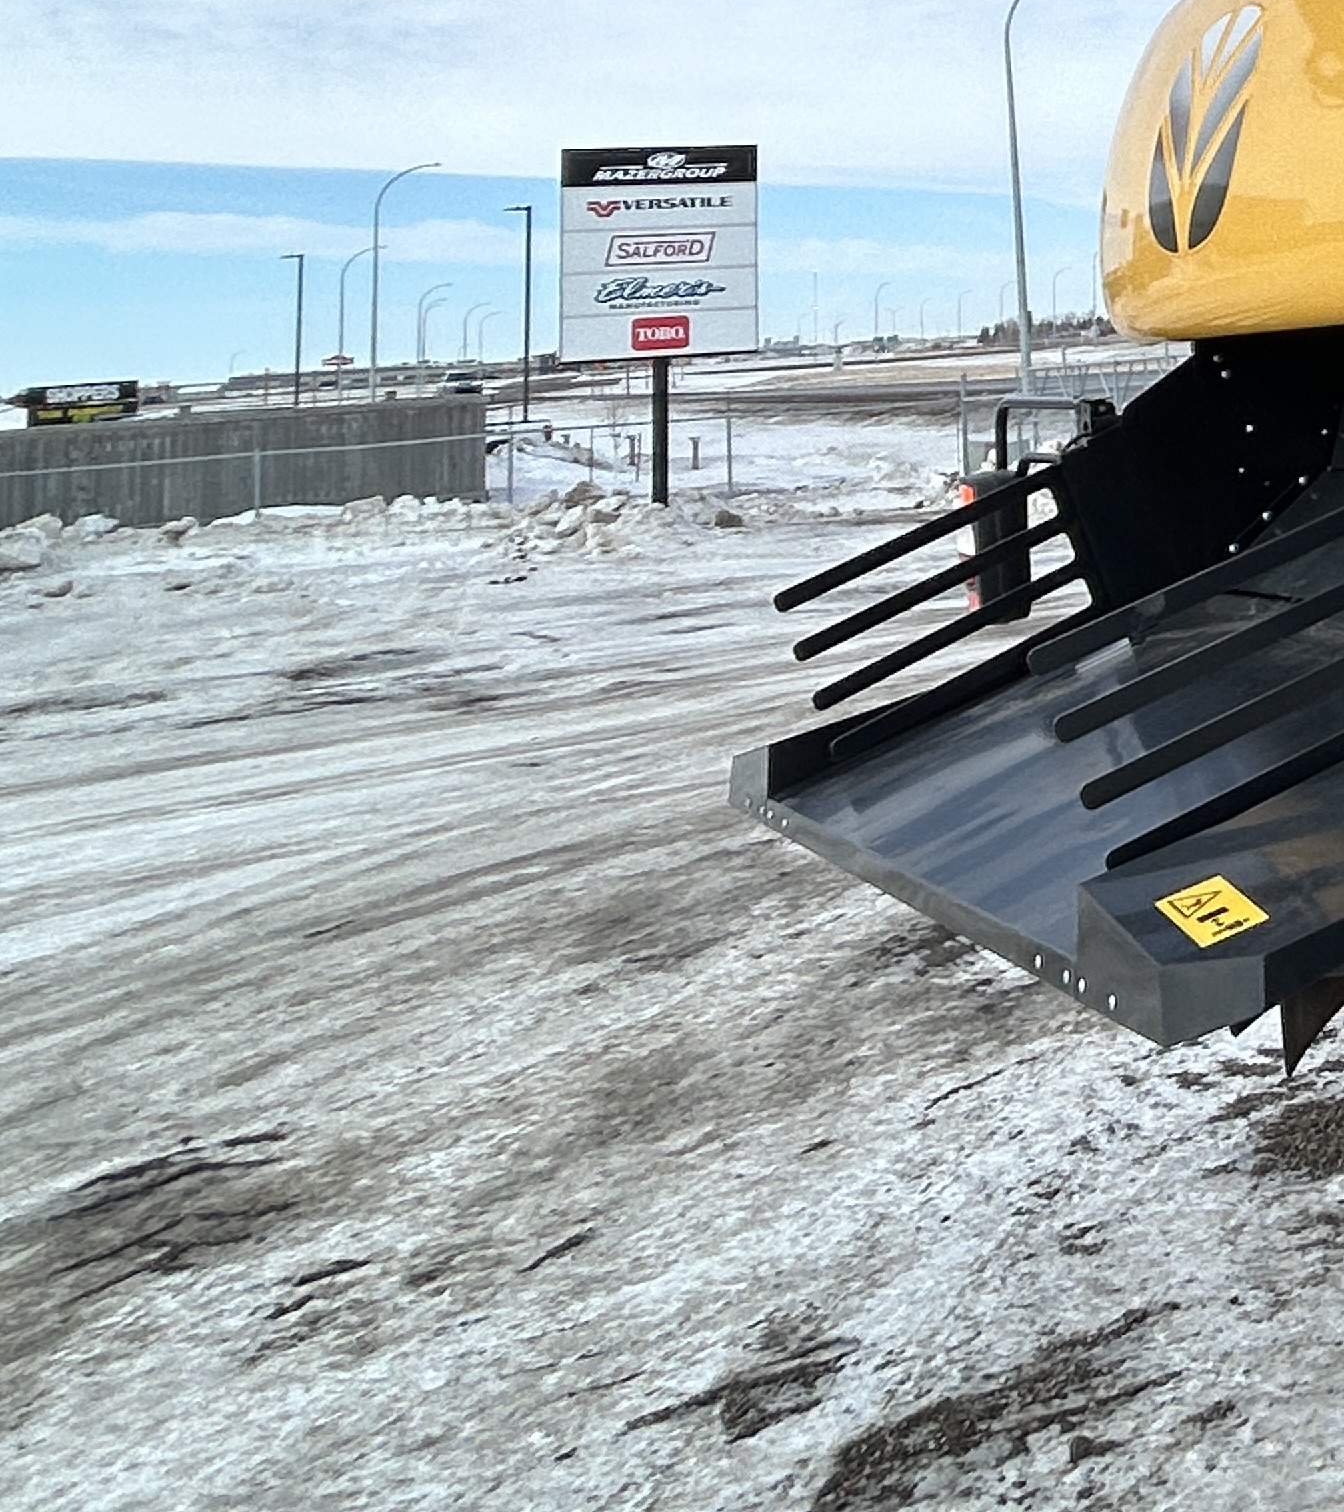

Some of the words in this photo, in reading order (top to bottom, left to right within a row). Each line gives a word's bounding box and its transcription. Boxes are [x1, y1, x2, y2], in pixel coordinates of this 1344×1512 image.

[593, 167, 726, 181] MAZERGROUP
[622, 196, 732, 209] VERSATILE
[616, 239, 704, 259] SALFORD
